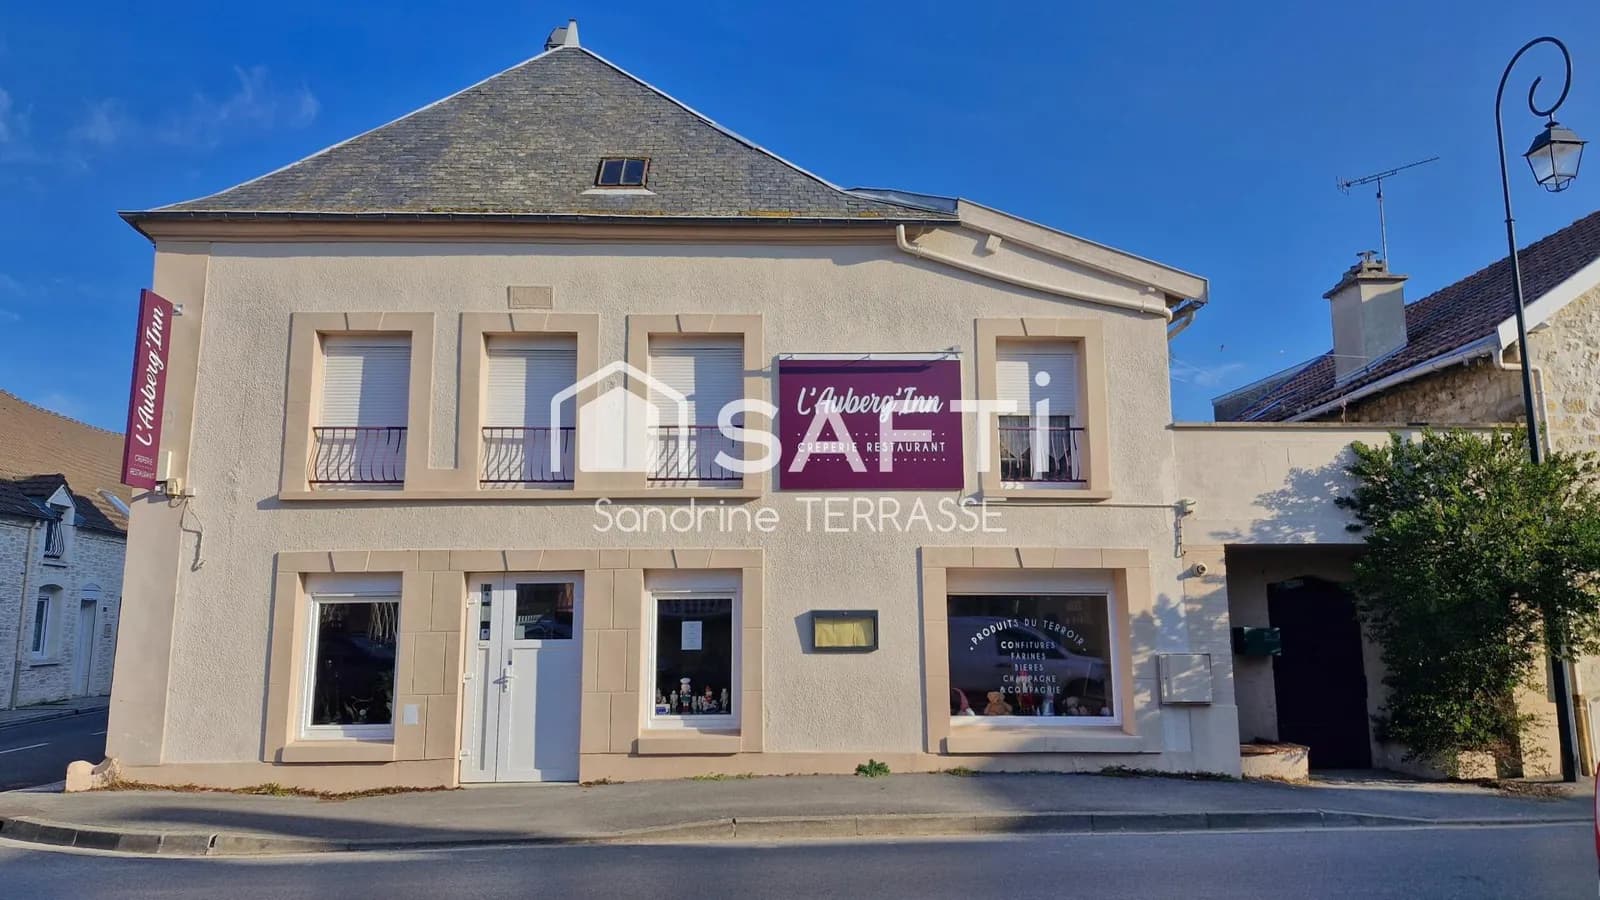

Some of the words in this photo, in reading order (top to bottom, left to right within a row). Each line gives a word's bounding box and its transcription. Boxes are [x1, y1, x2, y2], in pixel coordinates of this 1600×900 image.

[135, 305, 165, 446] L'Auberg'Inn
[797, 386, 944, 423] L'Auberg'Inn
[866, 441, 945, 453] RESTAURANT
[971, 619, 1019, 645] PRODUITS
[1024, 618, 1037, 627] DU
[1043, 620, 1084, 646] TERROIR
[1000, 641, 1056, 649] CONFITURES
[1011, 652, 1046, 660] FARINES
[1003, 674, 1056, 683] CHAMPAGNE
